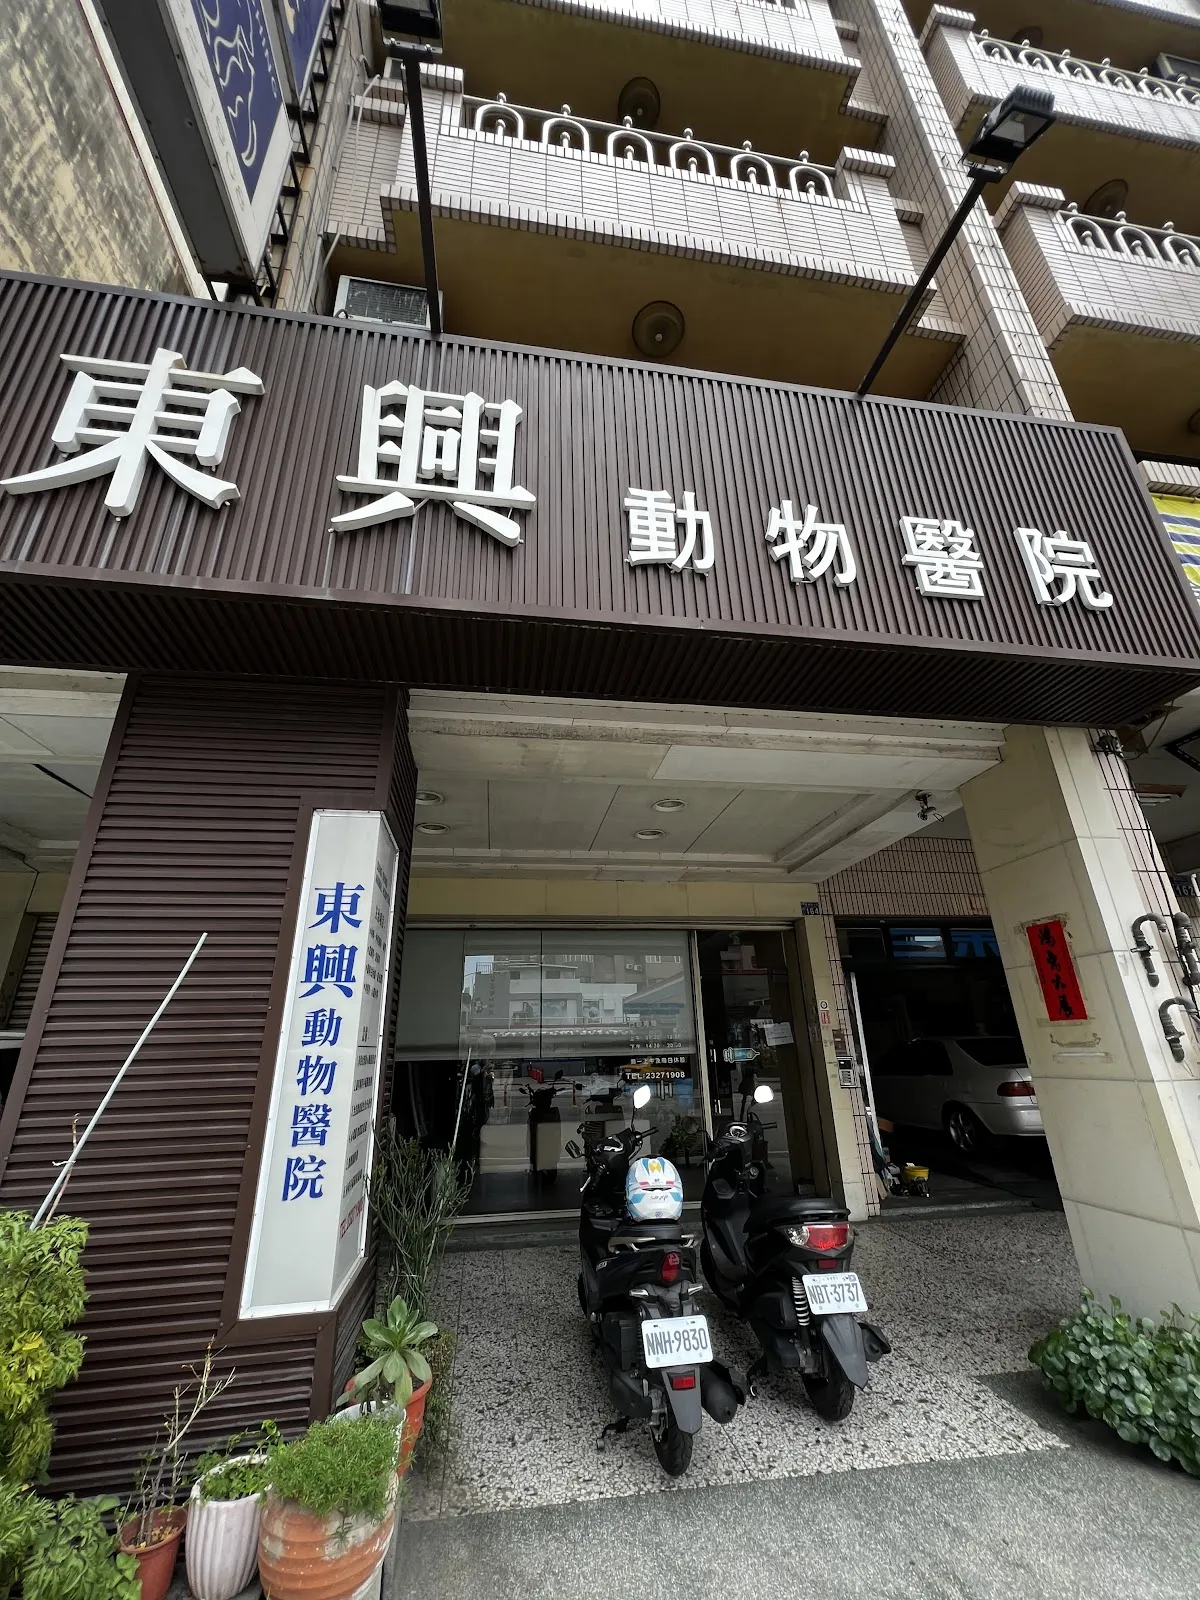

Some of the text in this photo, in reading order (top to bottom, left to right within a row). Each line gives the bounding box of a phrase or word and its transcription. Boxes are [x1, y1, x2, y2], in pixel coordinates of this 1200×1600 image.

[0, 347, 1113, 612] 東興動物醫院
[281, 881, 365, 1202] 東興動物醫院
